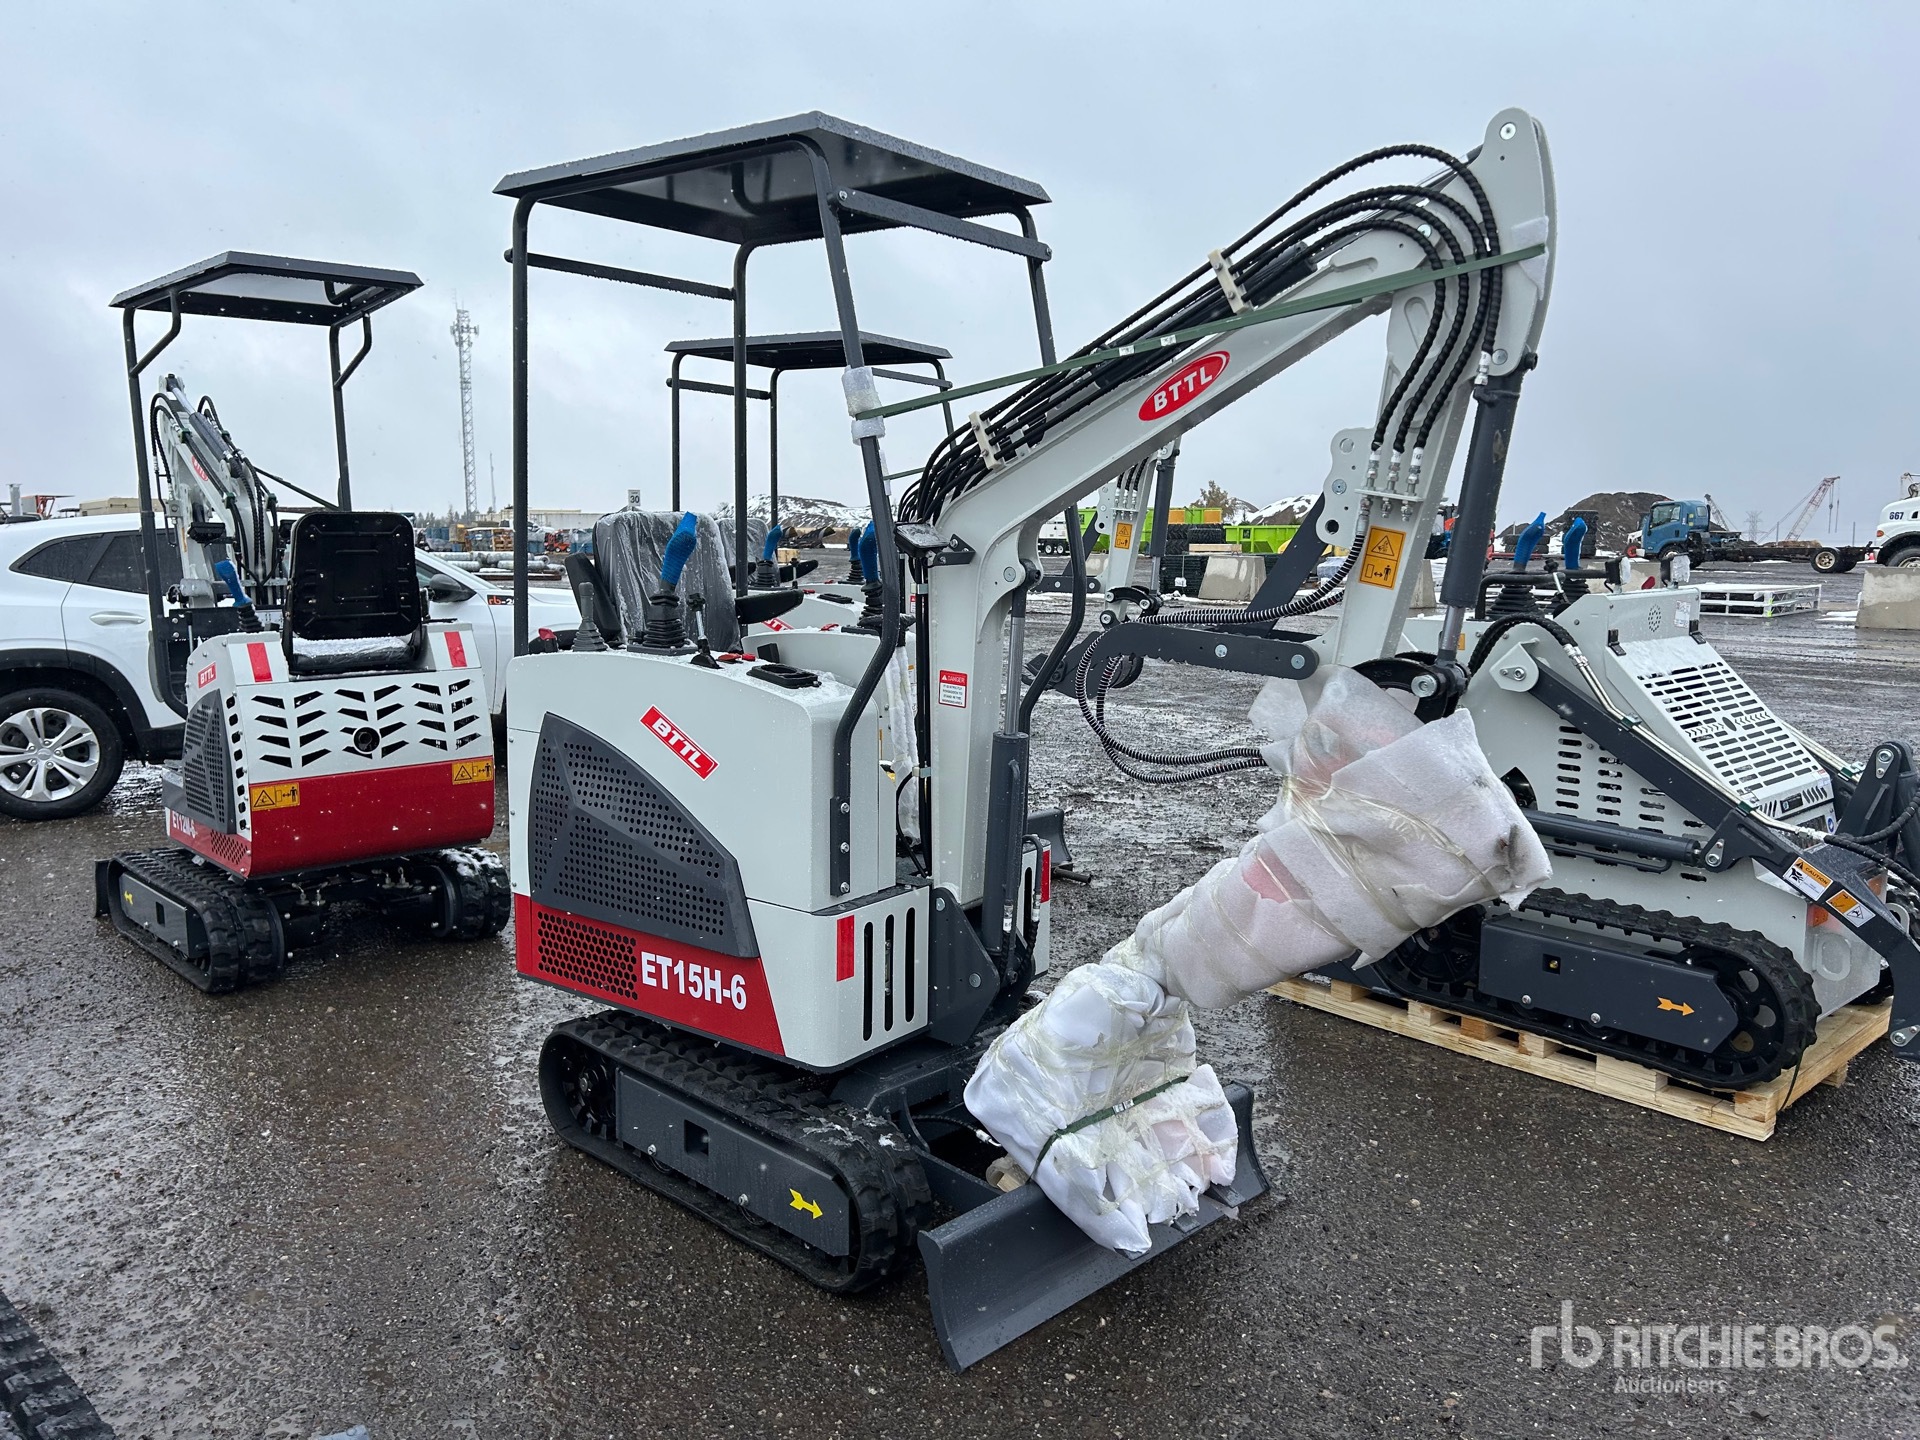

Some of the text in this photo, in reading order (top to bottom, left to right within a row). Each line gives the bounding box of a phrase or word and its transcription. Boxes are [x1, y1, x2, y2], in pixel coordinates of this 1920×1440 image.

[1153, 366, 1213, 413] BTTL
[1889, 511, 1904, 520] 667
[200, 667, 215, 685] BTTL
[947, 675, 965, 683] DANGER
[651, 717, 702, 769] BTTL
[1805, 866, 1828, 885] CAUTION
[641, 951, 747, 1010] ET15H-6
